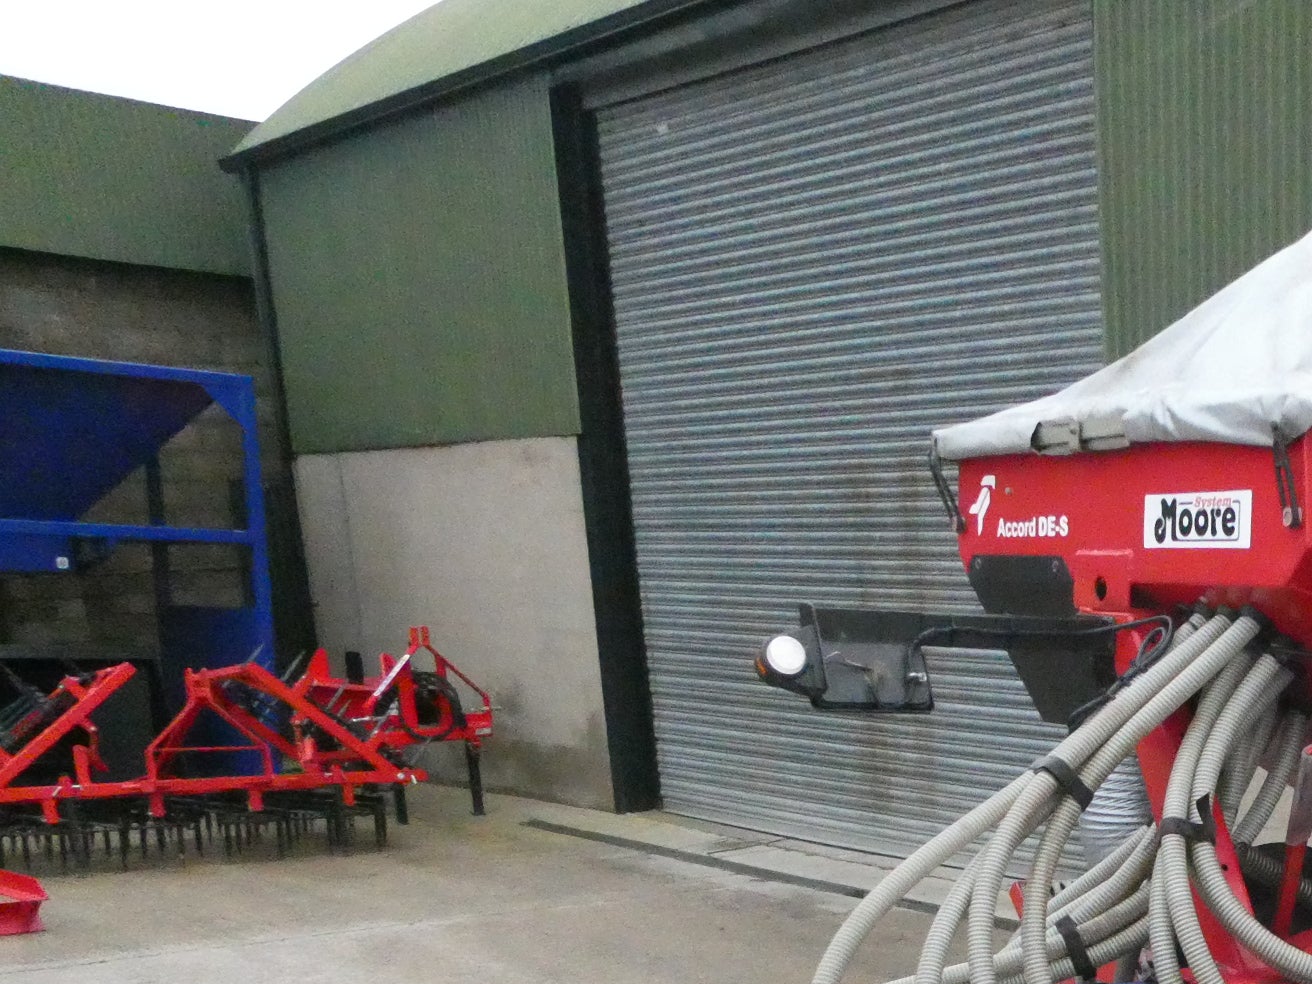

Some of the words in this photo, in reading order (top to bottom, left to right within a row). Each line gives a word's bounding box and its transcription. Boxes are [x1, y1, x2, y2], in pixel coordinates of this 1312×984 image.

[1194, 496, 1232, 509] System
[997, 516, 1036, 538] Accord
[1038, 515, 1069, 537] DE-S
[1154, 498, 1236, 544] Moore
